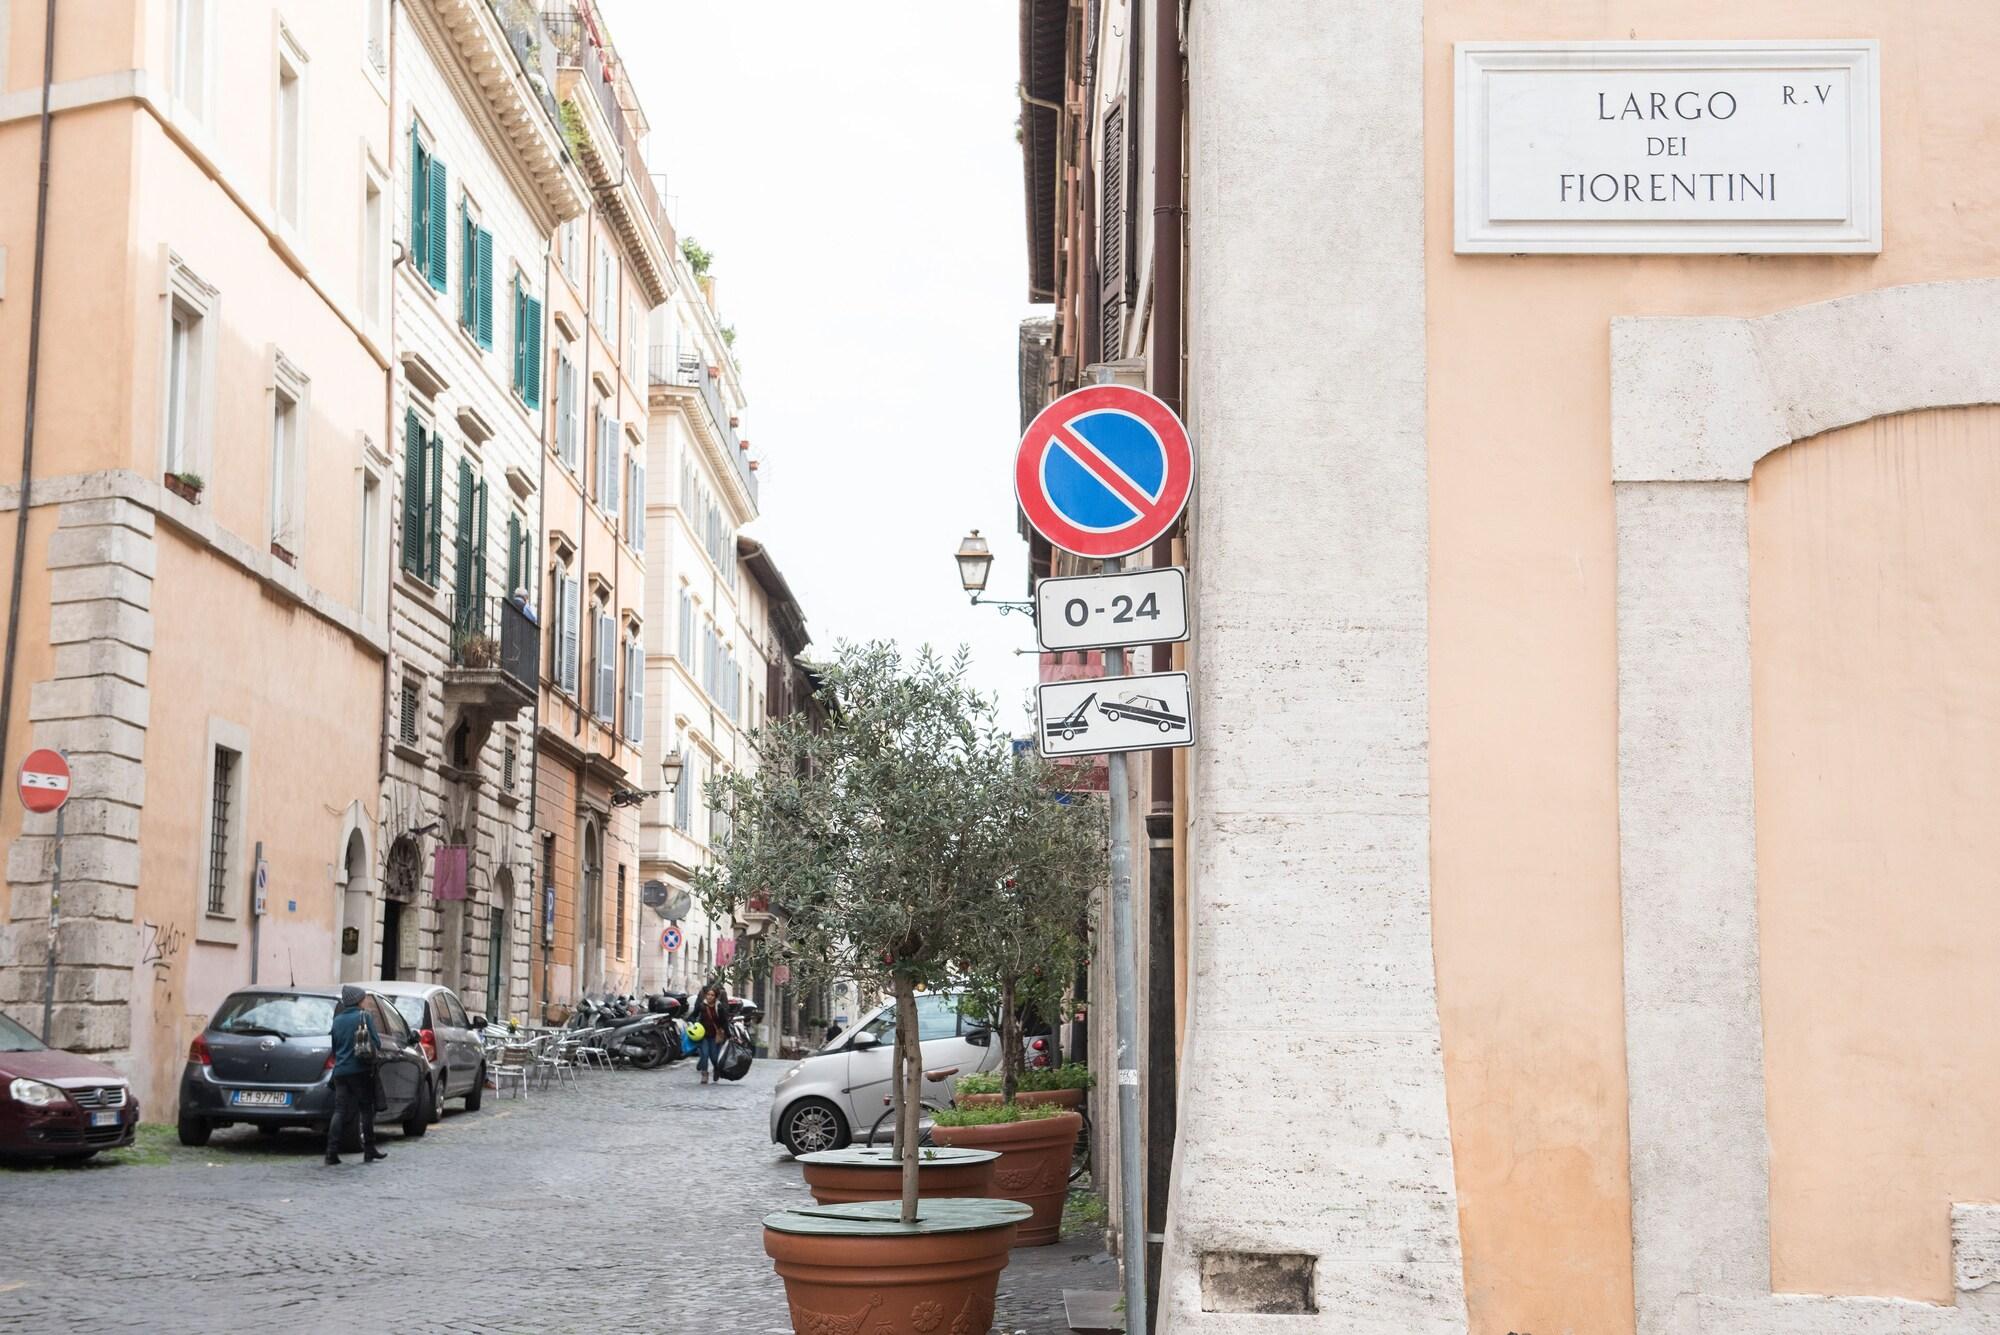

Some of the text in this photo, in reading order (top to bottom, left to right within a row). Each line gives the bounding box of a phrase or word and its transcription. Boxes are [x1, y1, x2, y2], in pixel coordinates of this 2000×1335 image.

[1599, 91, 1737, 120] LARGO
[1783, 84, 1831, 105] R.V
[1647, 136, 1686, 156] DEI
[1560, 173, 1775, 202] FIORENTINI
[1065, 592, 1160, 627] 0-24
